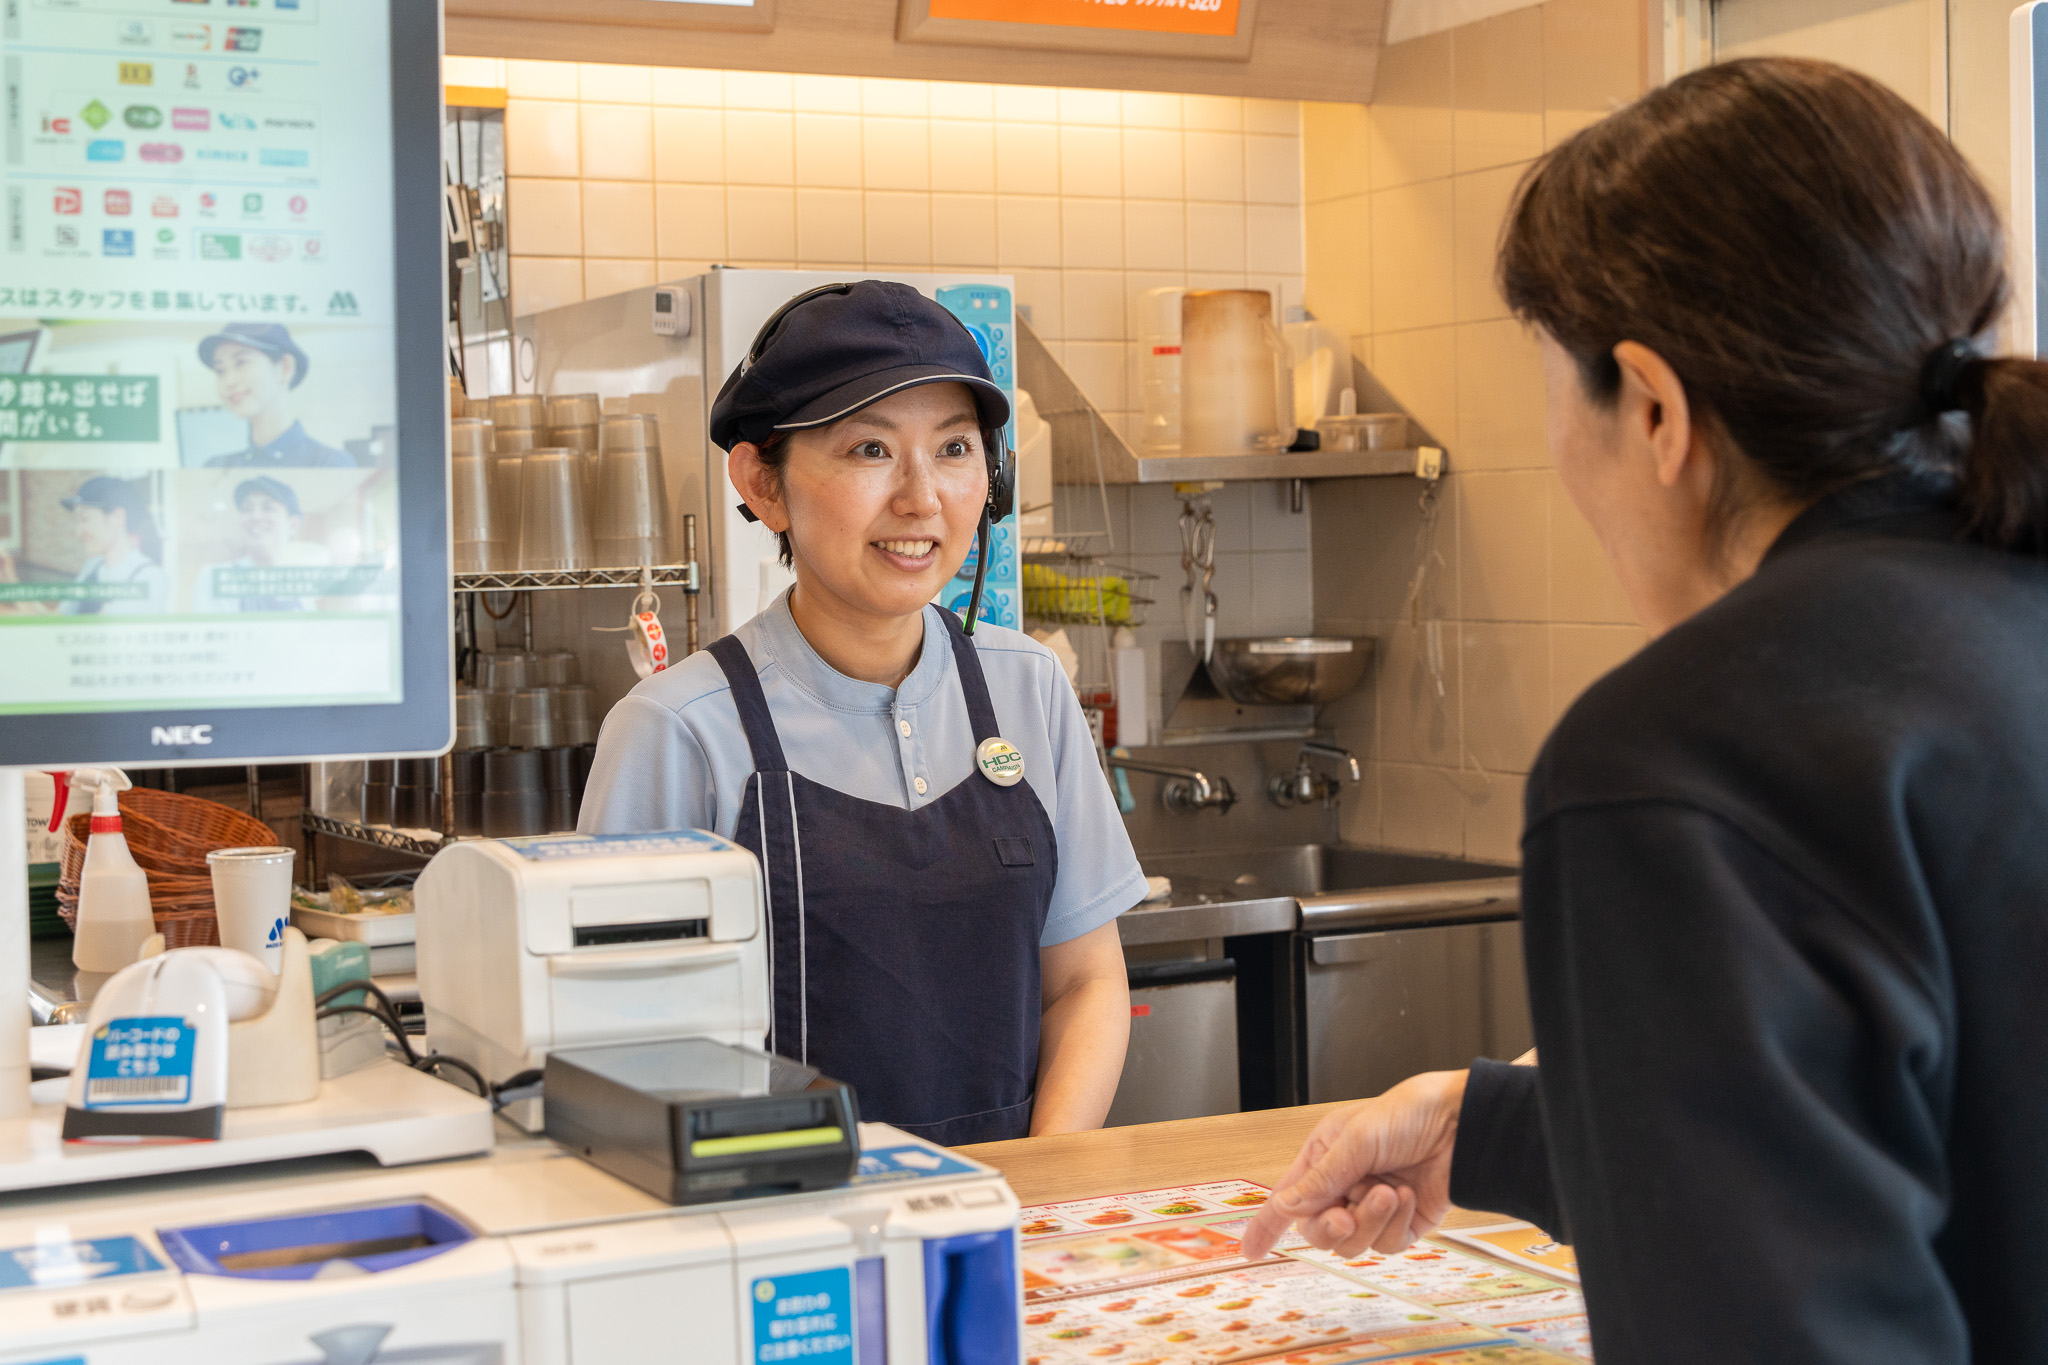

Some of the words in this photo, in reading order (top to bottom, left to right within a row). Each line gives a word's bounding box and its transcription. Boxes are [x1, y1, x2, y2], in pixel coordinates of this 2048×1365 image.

[151, 725, 213, 745] NEC
[982, 752, 1021, 769] HDC
[991, 763, 1021, 773] CAMPAIGN
